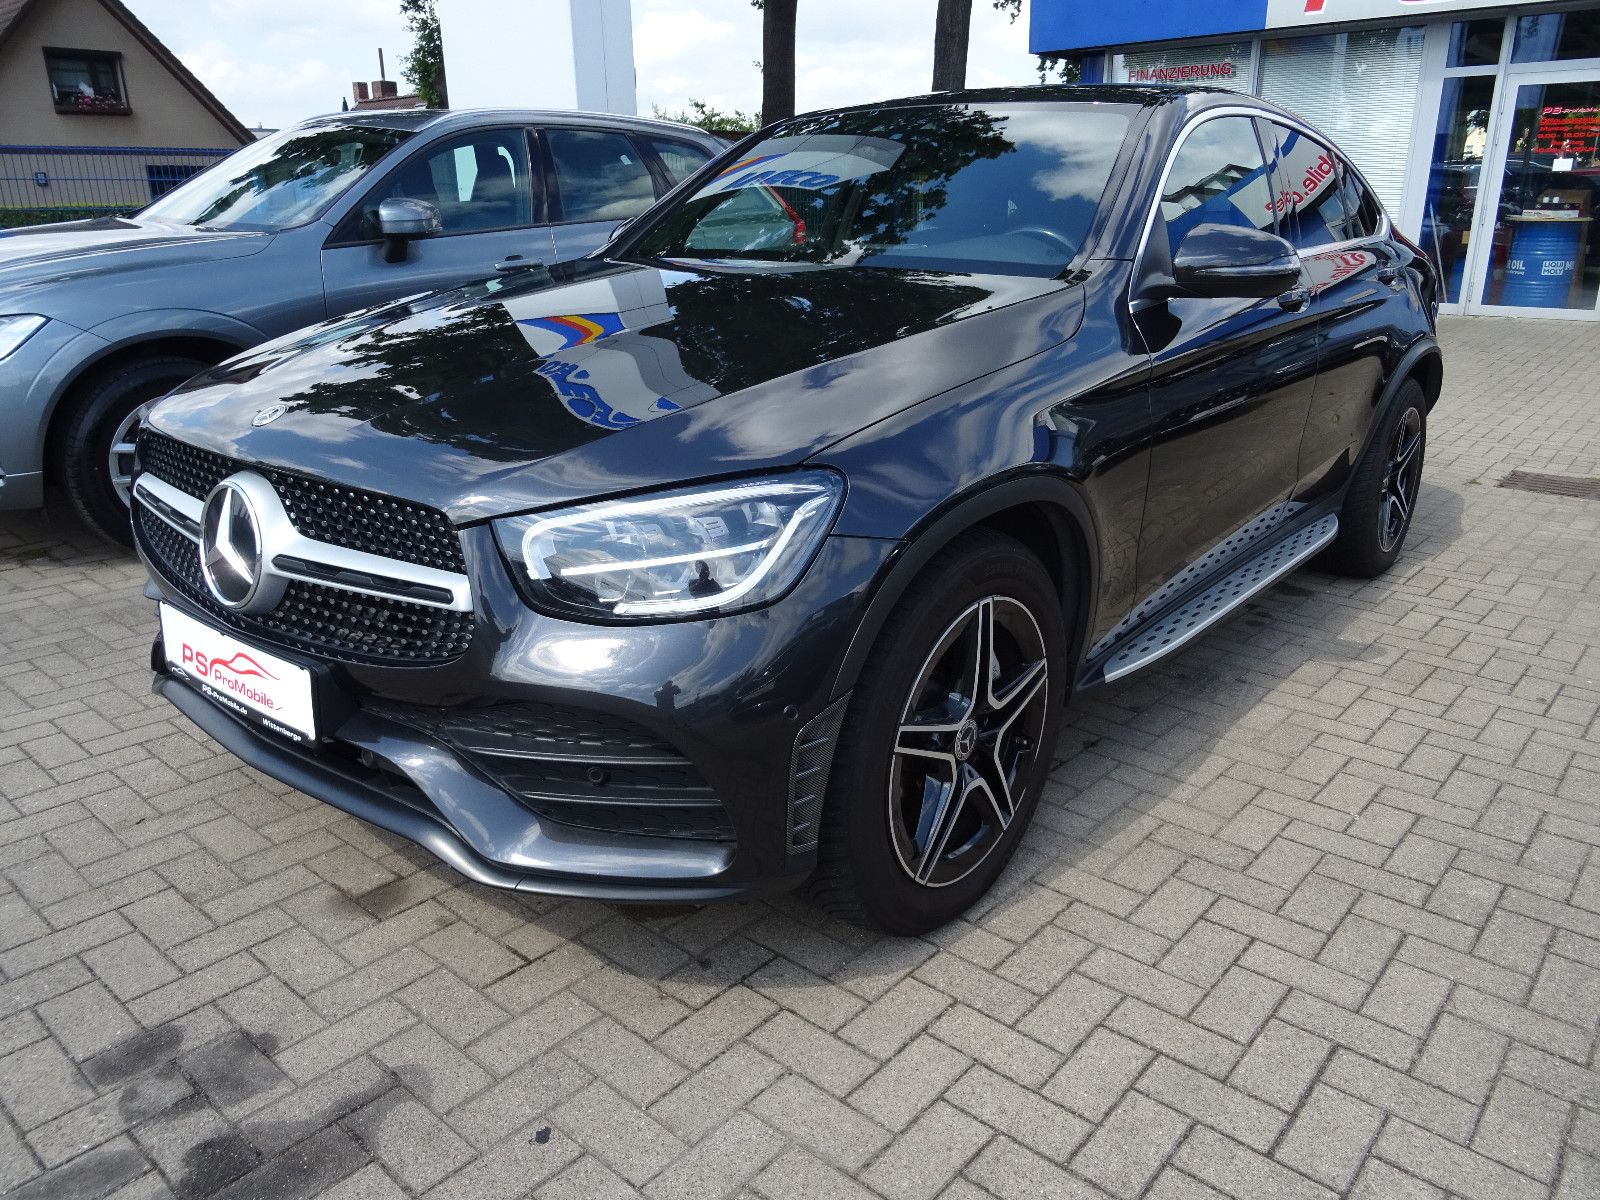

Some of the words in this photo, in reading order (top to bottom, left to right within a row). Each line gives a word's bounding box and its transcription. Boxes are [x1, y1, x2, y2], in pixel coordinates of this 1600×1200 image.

[1128, 62, 1232, 82] FINANZIERUNG
[182, 642, 208, 677] PS
[202, 684, 248, 715] PS-ProMobile.de
[214, 668, 274, 709] ProMobile
[262, 717, 302, 741] Wittenberge
